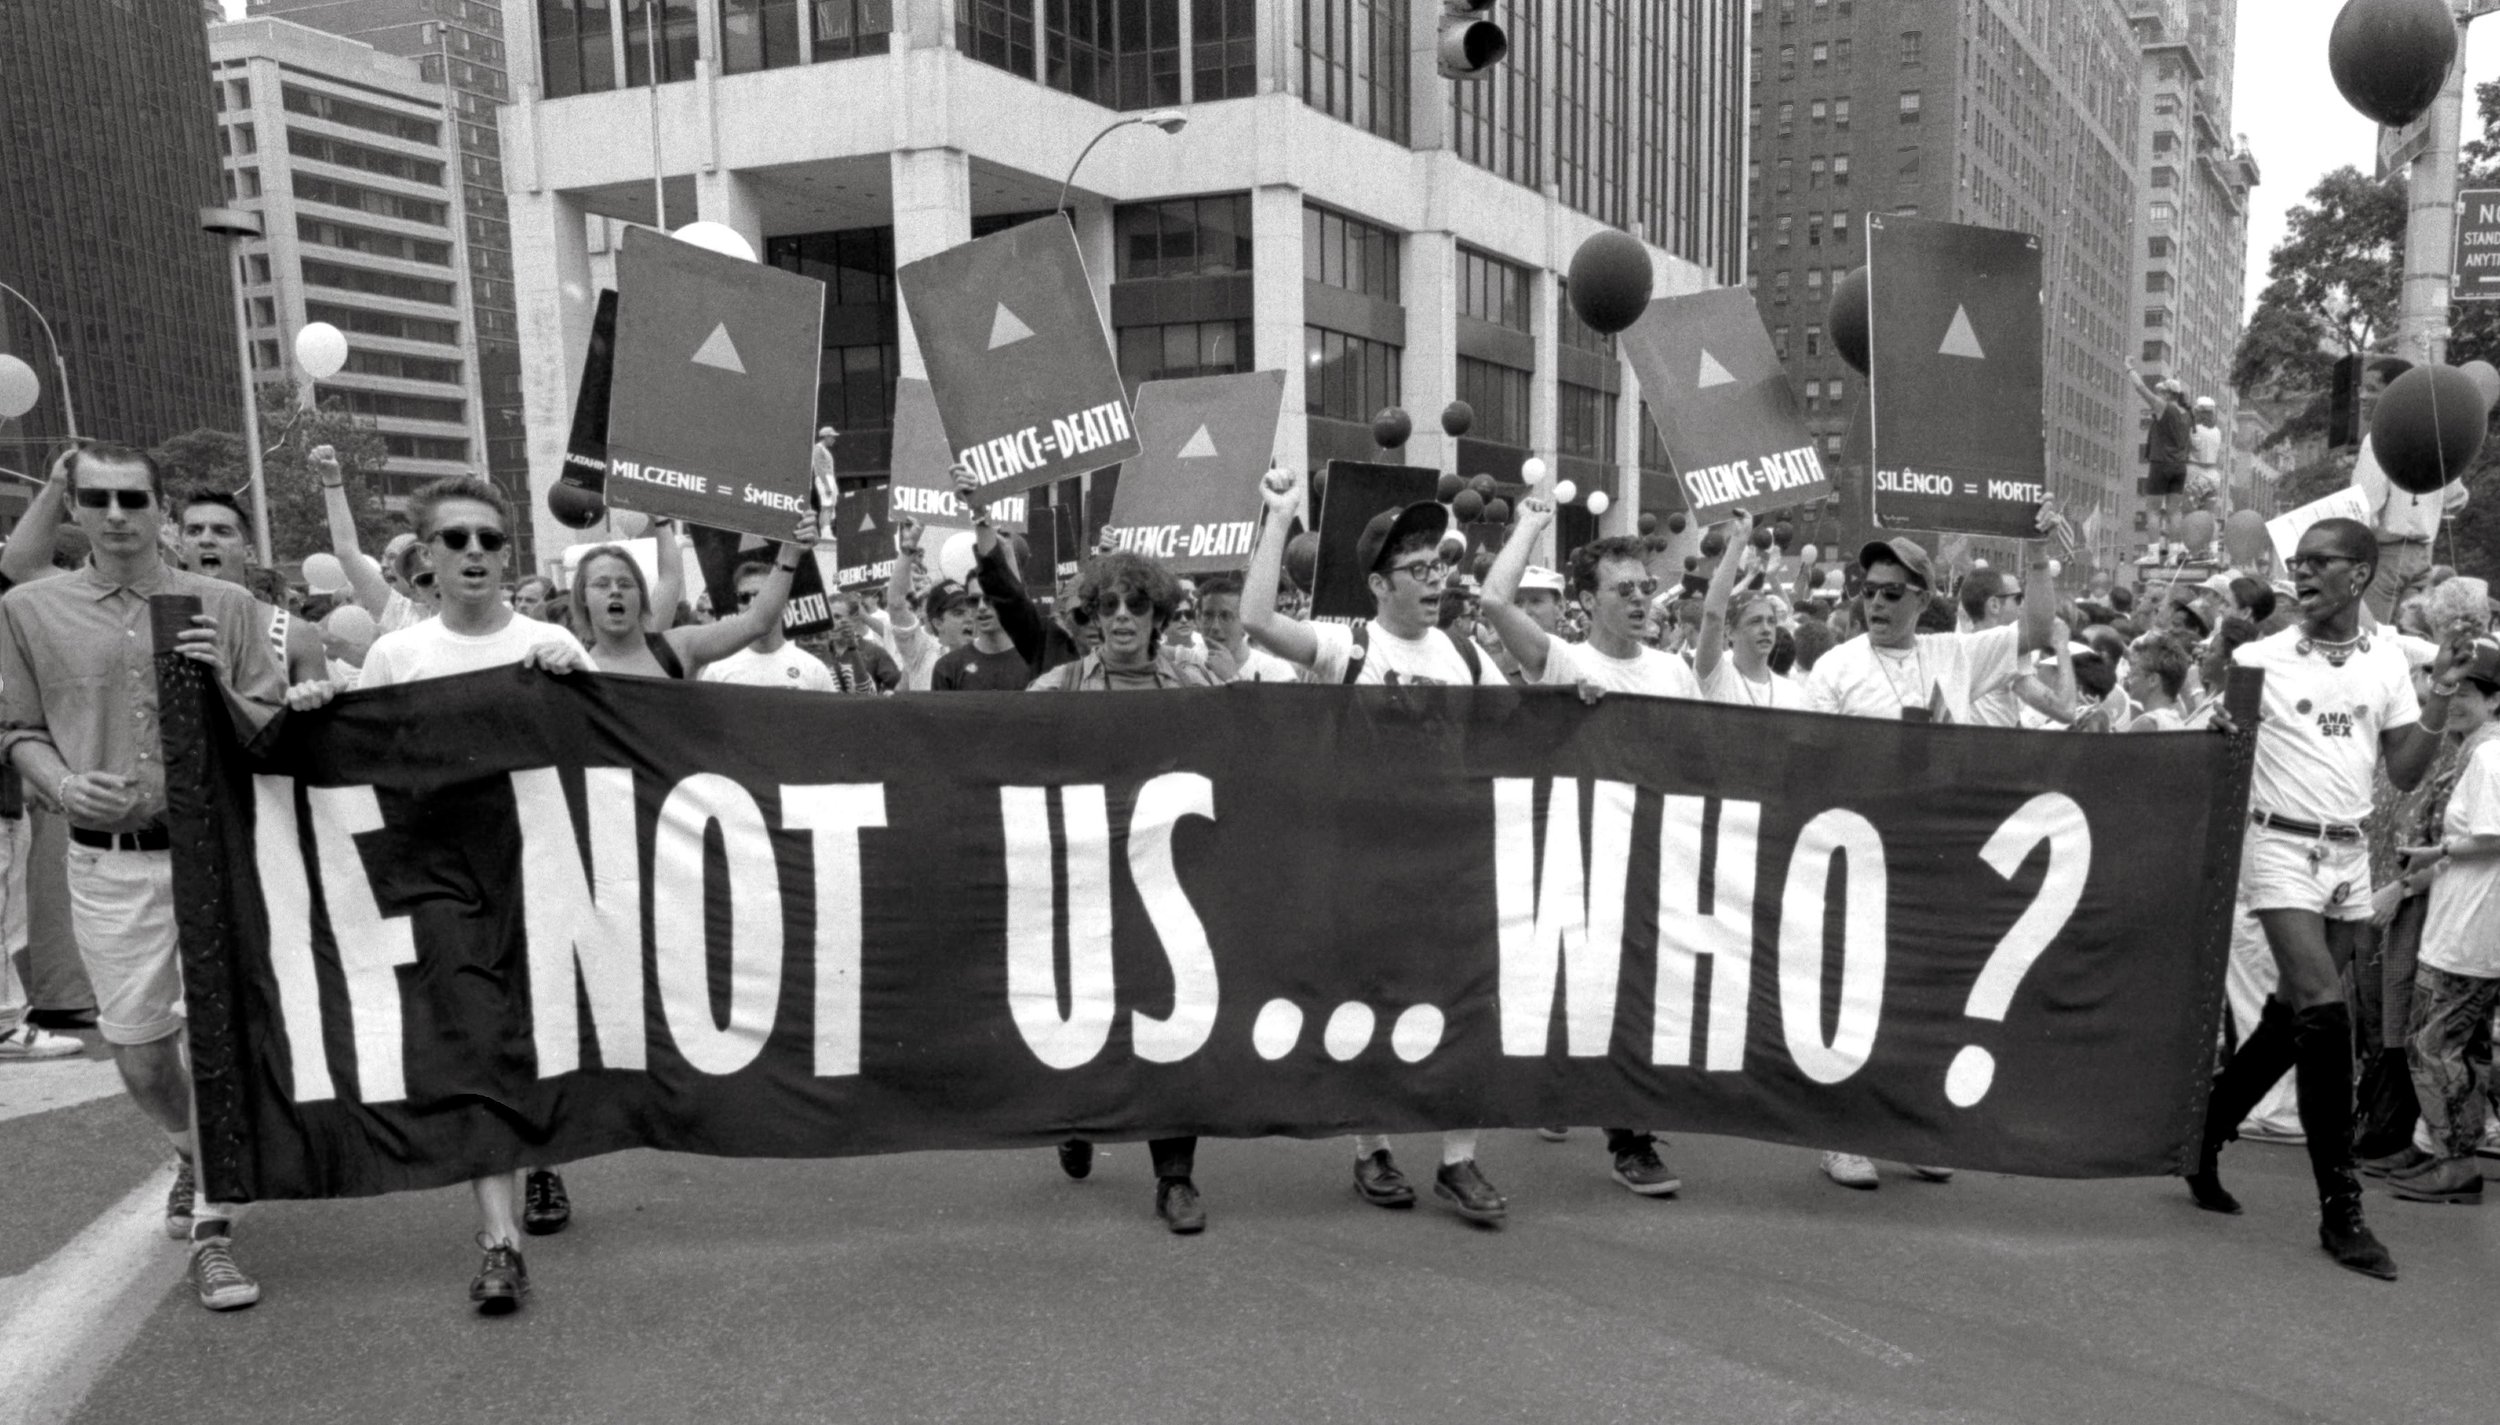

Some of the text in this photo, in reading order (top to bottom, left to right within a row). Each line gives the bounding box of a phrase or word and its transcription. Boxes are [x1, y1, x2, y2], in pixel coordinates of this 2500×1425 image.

[2480, 204, 2500, 223] N
[611, 458, 707, 494] MILCZENIE
[743, 483, 805, 514] ŚMIERĆ
[1685, 446, 1825, 508] SILENCE=DEATH
[1877, 467, 1953, 496] SILÊNCIO
[1988, 478, 2043, 504] MORTE
[2322, 724, 2352, 737] SEX
[253, 774, 417, 1102] IF
[509, 767, 887, 1078] NOT
